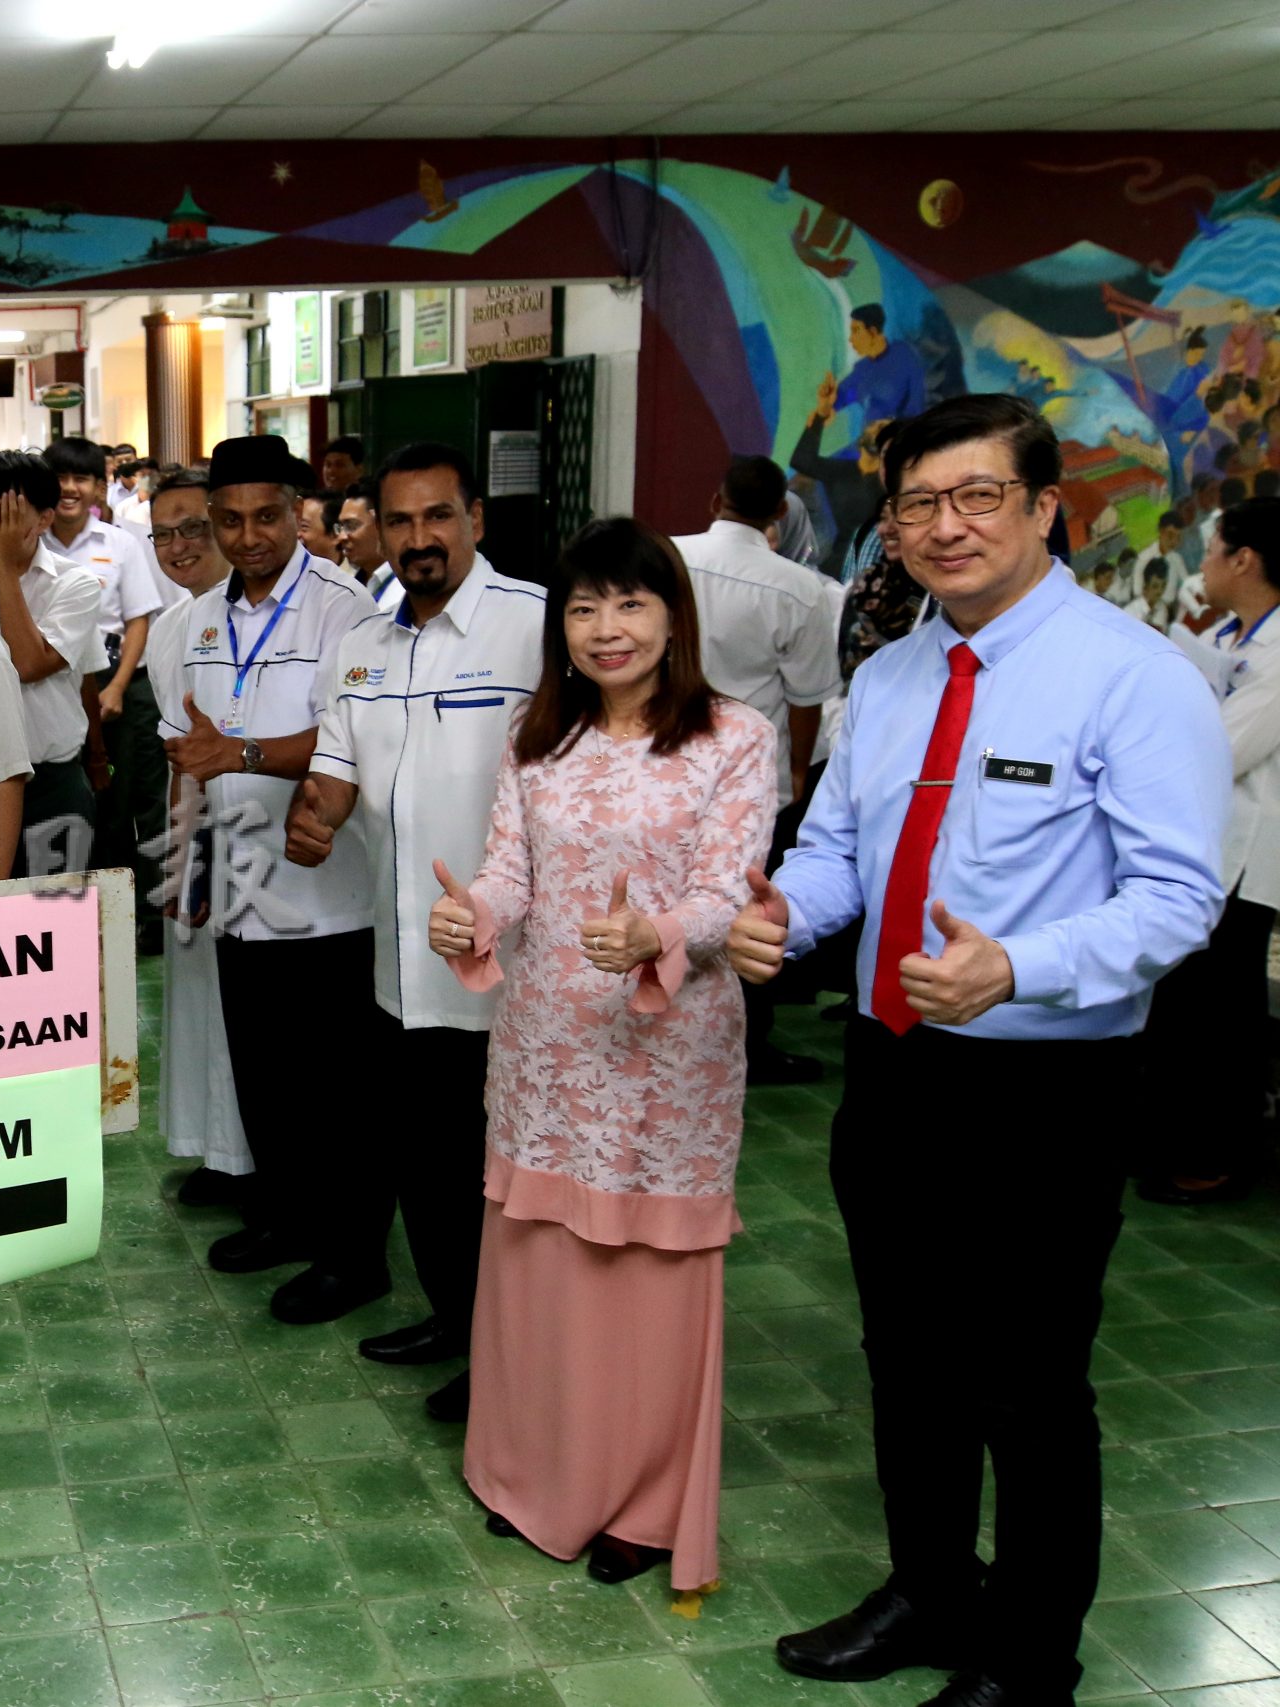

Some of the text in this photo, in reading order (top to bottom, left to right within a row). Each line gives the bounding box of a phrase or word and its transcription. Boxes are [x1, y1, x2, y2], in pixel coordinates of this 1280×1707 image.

[503, 335, 549, 357] ARCHIVES
[1004, 765, 1035, 777] HP GOH
